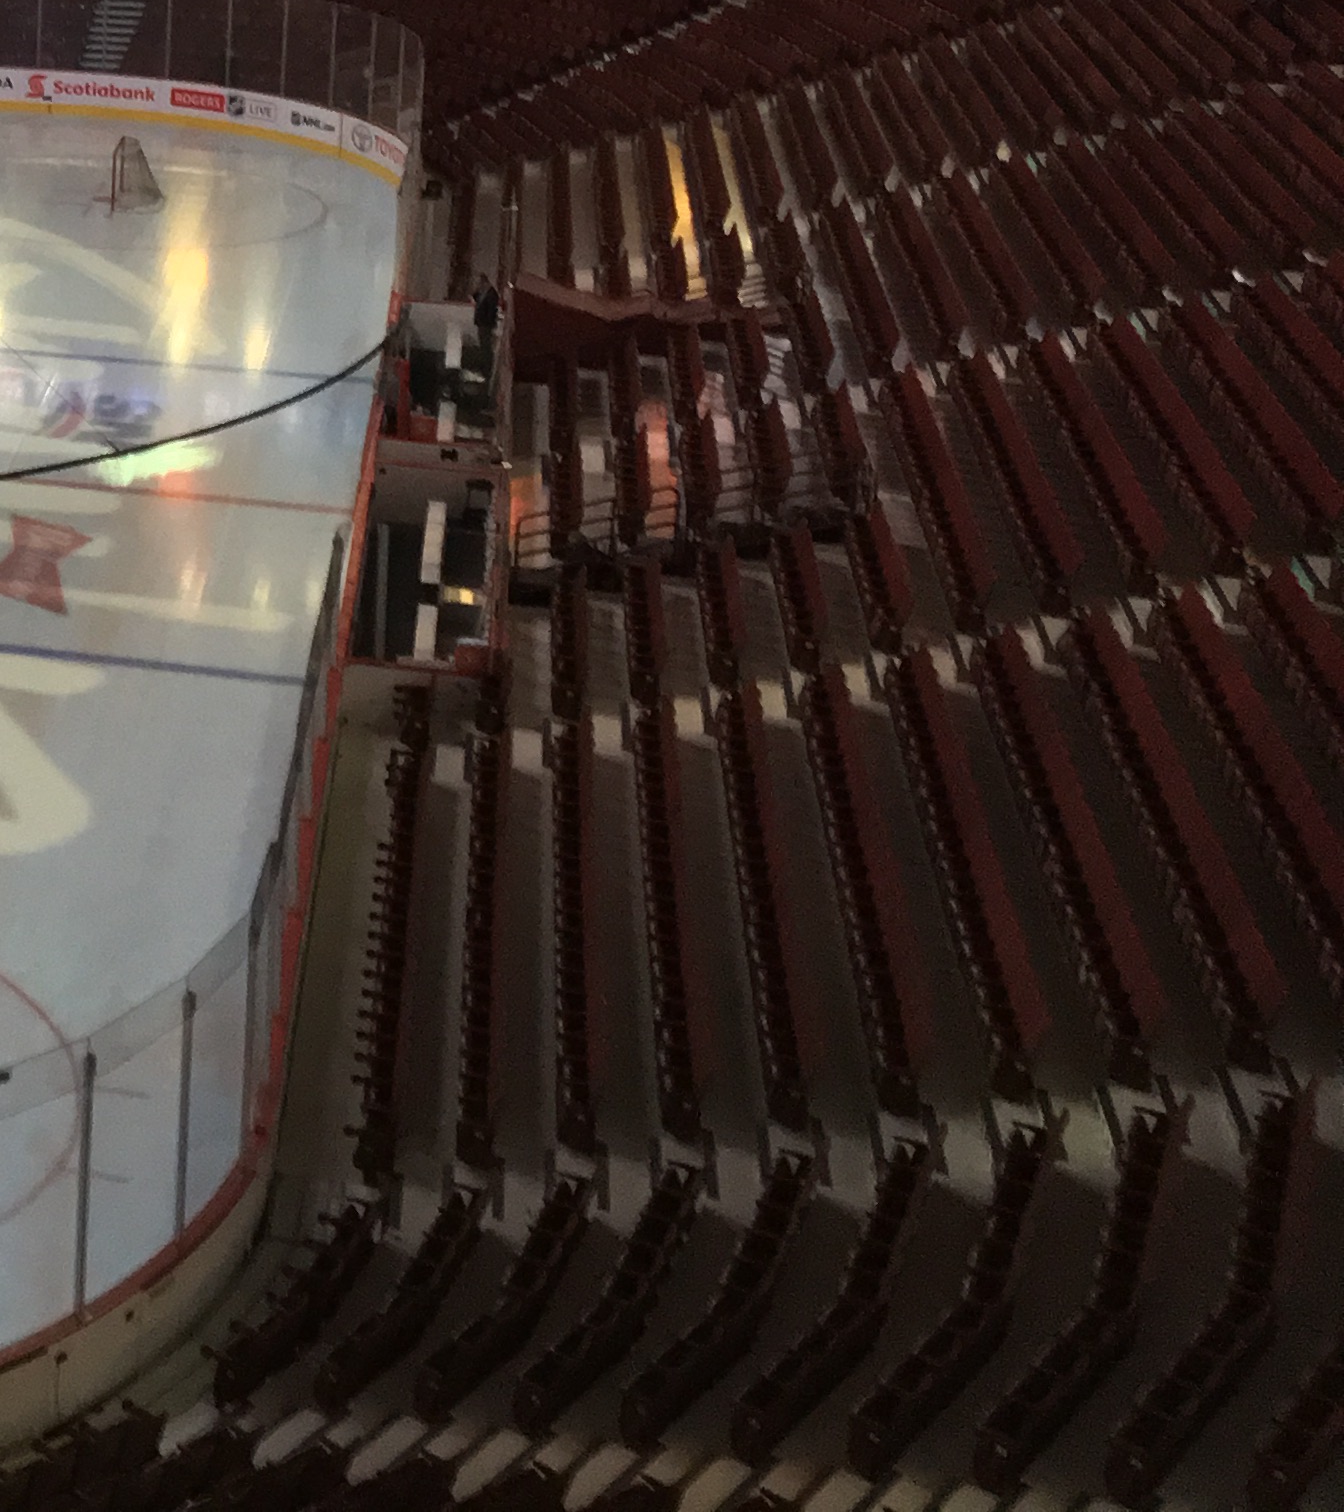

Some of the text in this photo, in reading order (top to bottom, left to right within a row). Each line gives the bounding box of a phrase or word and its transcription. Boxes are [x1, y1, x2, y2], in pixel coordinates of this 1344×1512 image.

[53, 79, 156, 103] Scotiabank
[174, 91, 223, 110] ROGERS
[248, 104, 273, 120] LIVE
